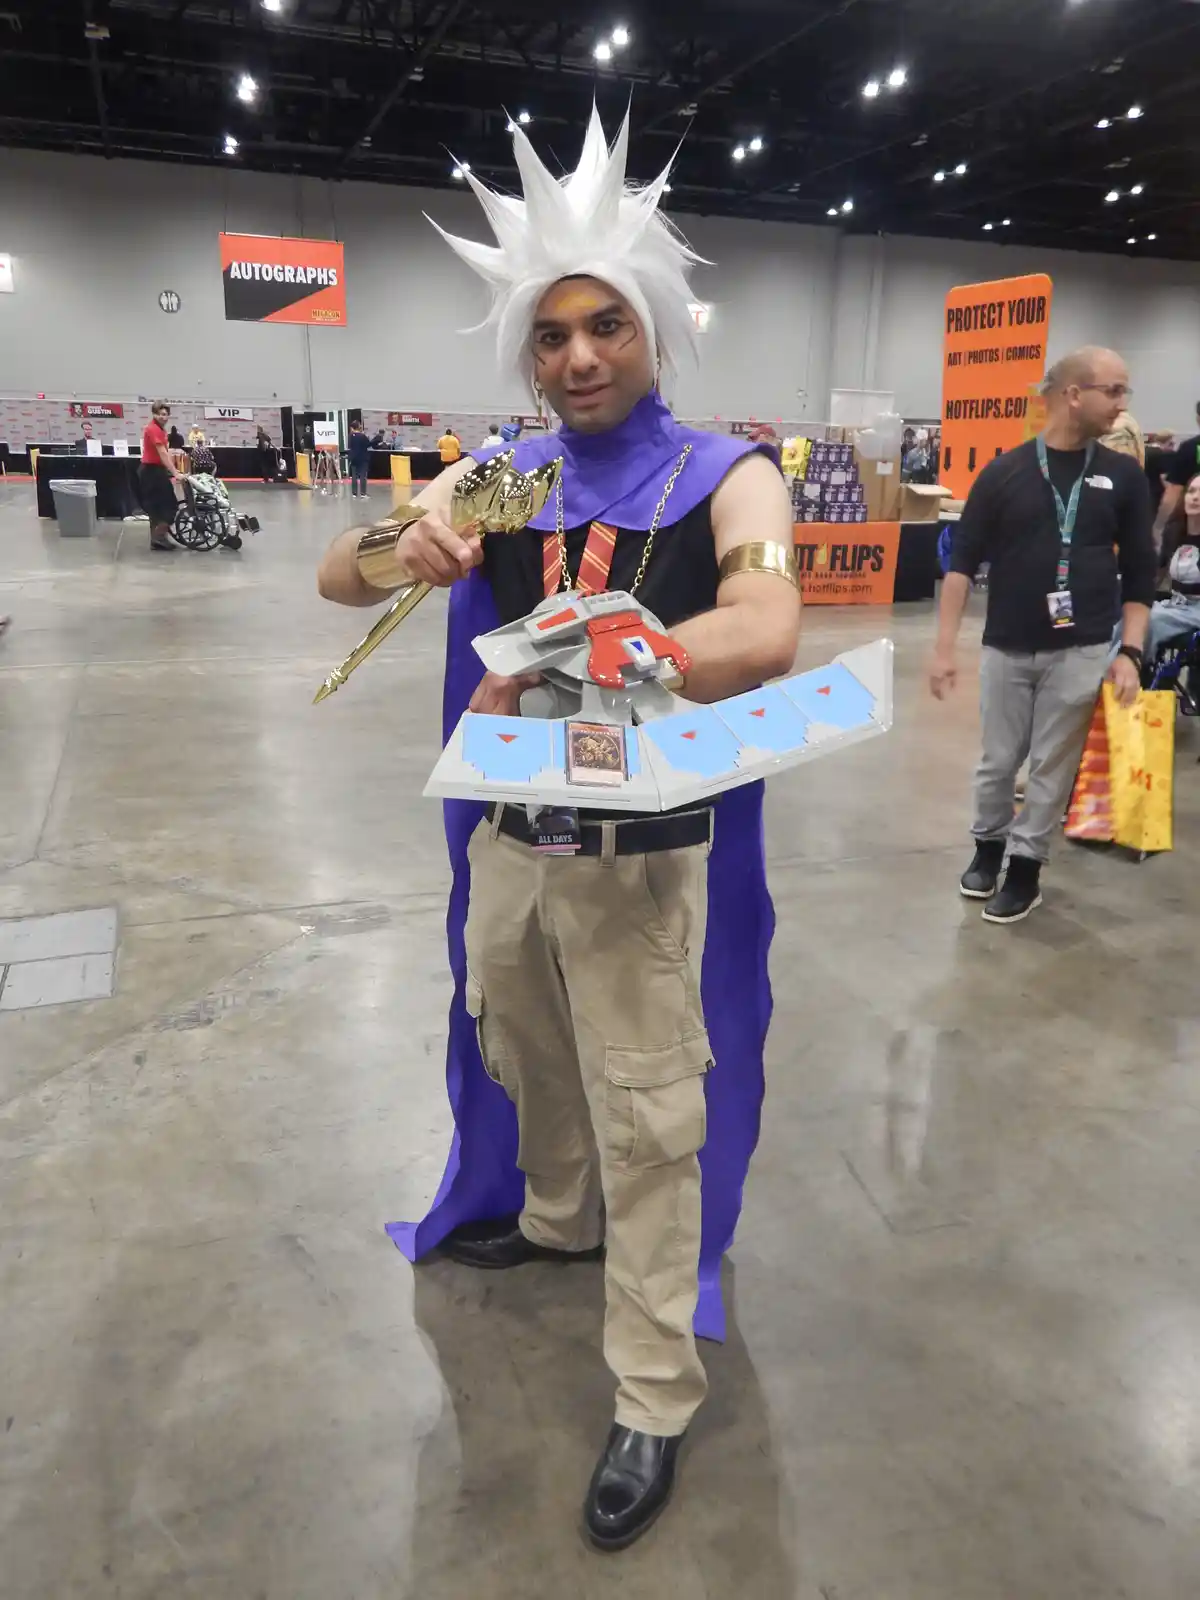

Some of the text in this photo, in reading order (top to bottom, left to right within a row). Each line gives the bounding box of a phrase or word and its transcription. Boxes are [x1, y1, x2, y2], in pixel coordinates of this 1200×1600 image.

[230, 261, 338, 286] AUTOGRAPHS
[947, 296, 1046, 334] PROTECT YOUR
[947, 344, 1041, 366] ART PHOTOS COMICS
[218, 408, 240, 417] VIP
[829, 543, 885, 572] FLIPS
[538, 834, 573, 844] ALL DAYS
